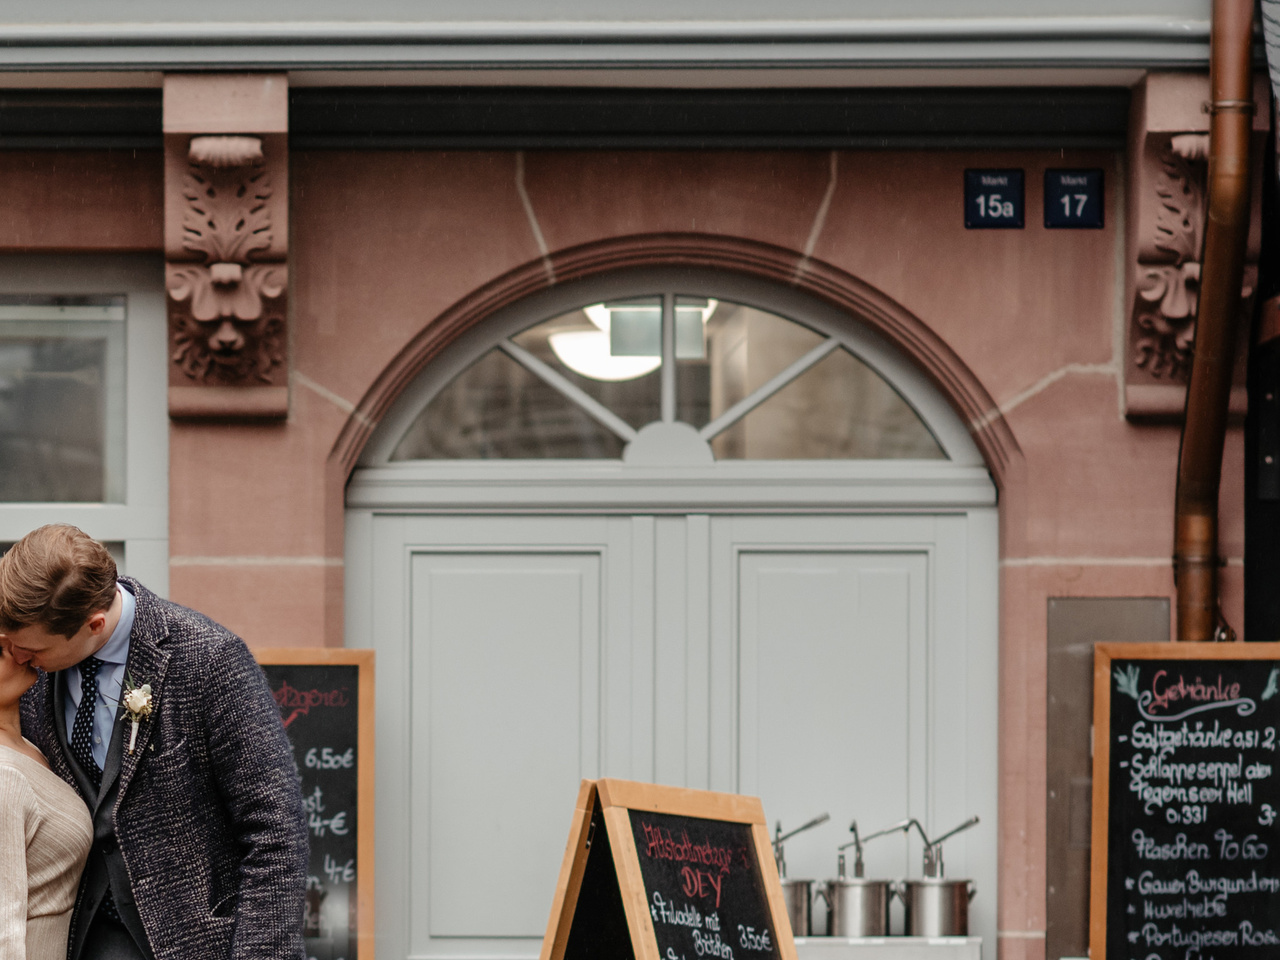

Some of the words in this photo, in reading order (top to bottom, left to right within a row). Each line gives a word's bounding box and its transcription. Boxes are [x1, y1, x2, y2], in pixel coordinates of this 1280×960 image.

[976, 194, 1014, 218] 15a
[1060, 194, 1088, 217] 17
[1147, 669, 1241, 714] Getränke
[1227, 780, 1253, 805] Hell
[681, 866, 723, 909] DEY
[705, 911, 720, 931] mit
